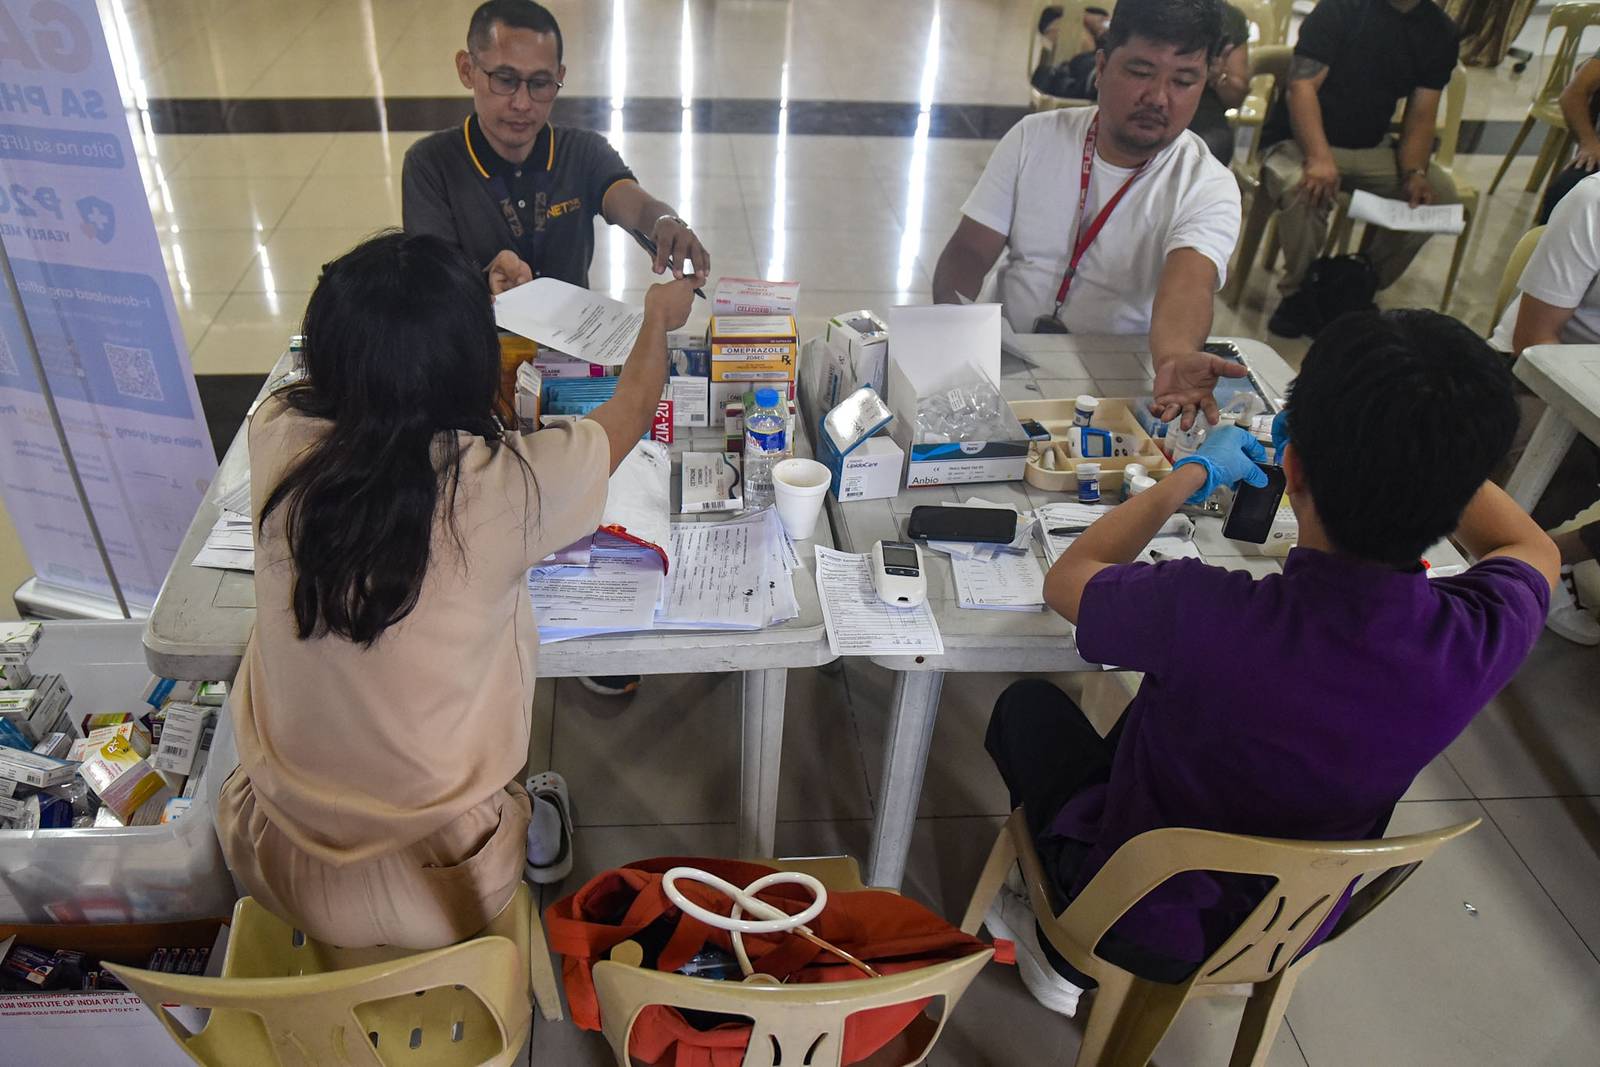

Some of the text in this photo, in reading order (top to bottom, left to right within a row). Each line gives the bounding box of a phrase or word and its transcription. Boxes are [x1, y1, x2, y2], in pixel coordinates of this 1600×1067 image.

[911, 476, 939, 485] Anbio
[17, 1000, 61, 1009] INSTITUTE
[63, 999, 76, 1007] OF
[77, 998, 101, 1006] INDIA
[123, 997, 141, 1005] LTD
